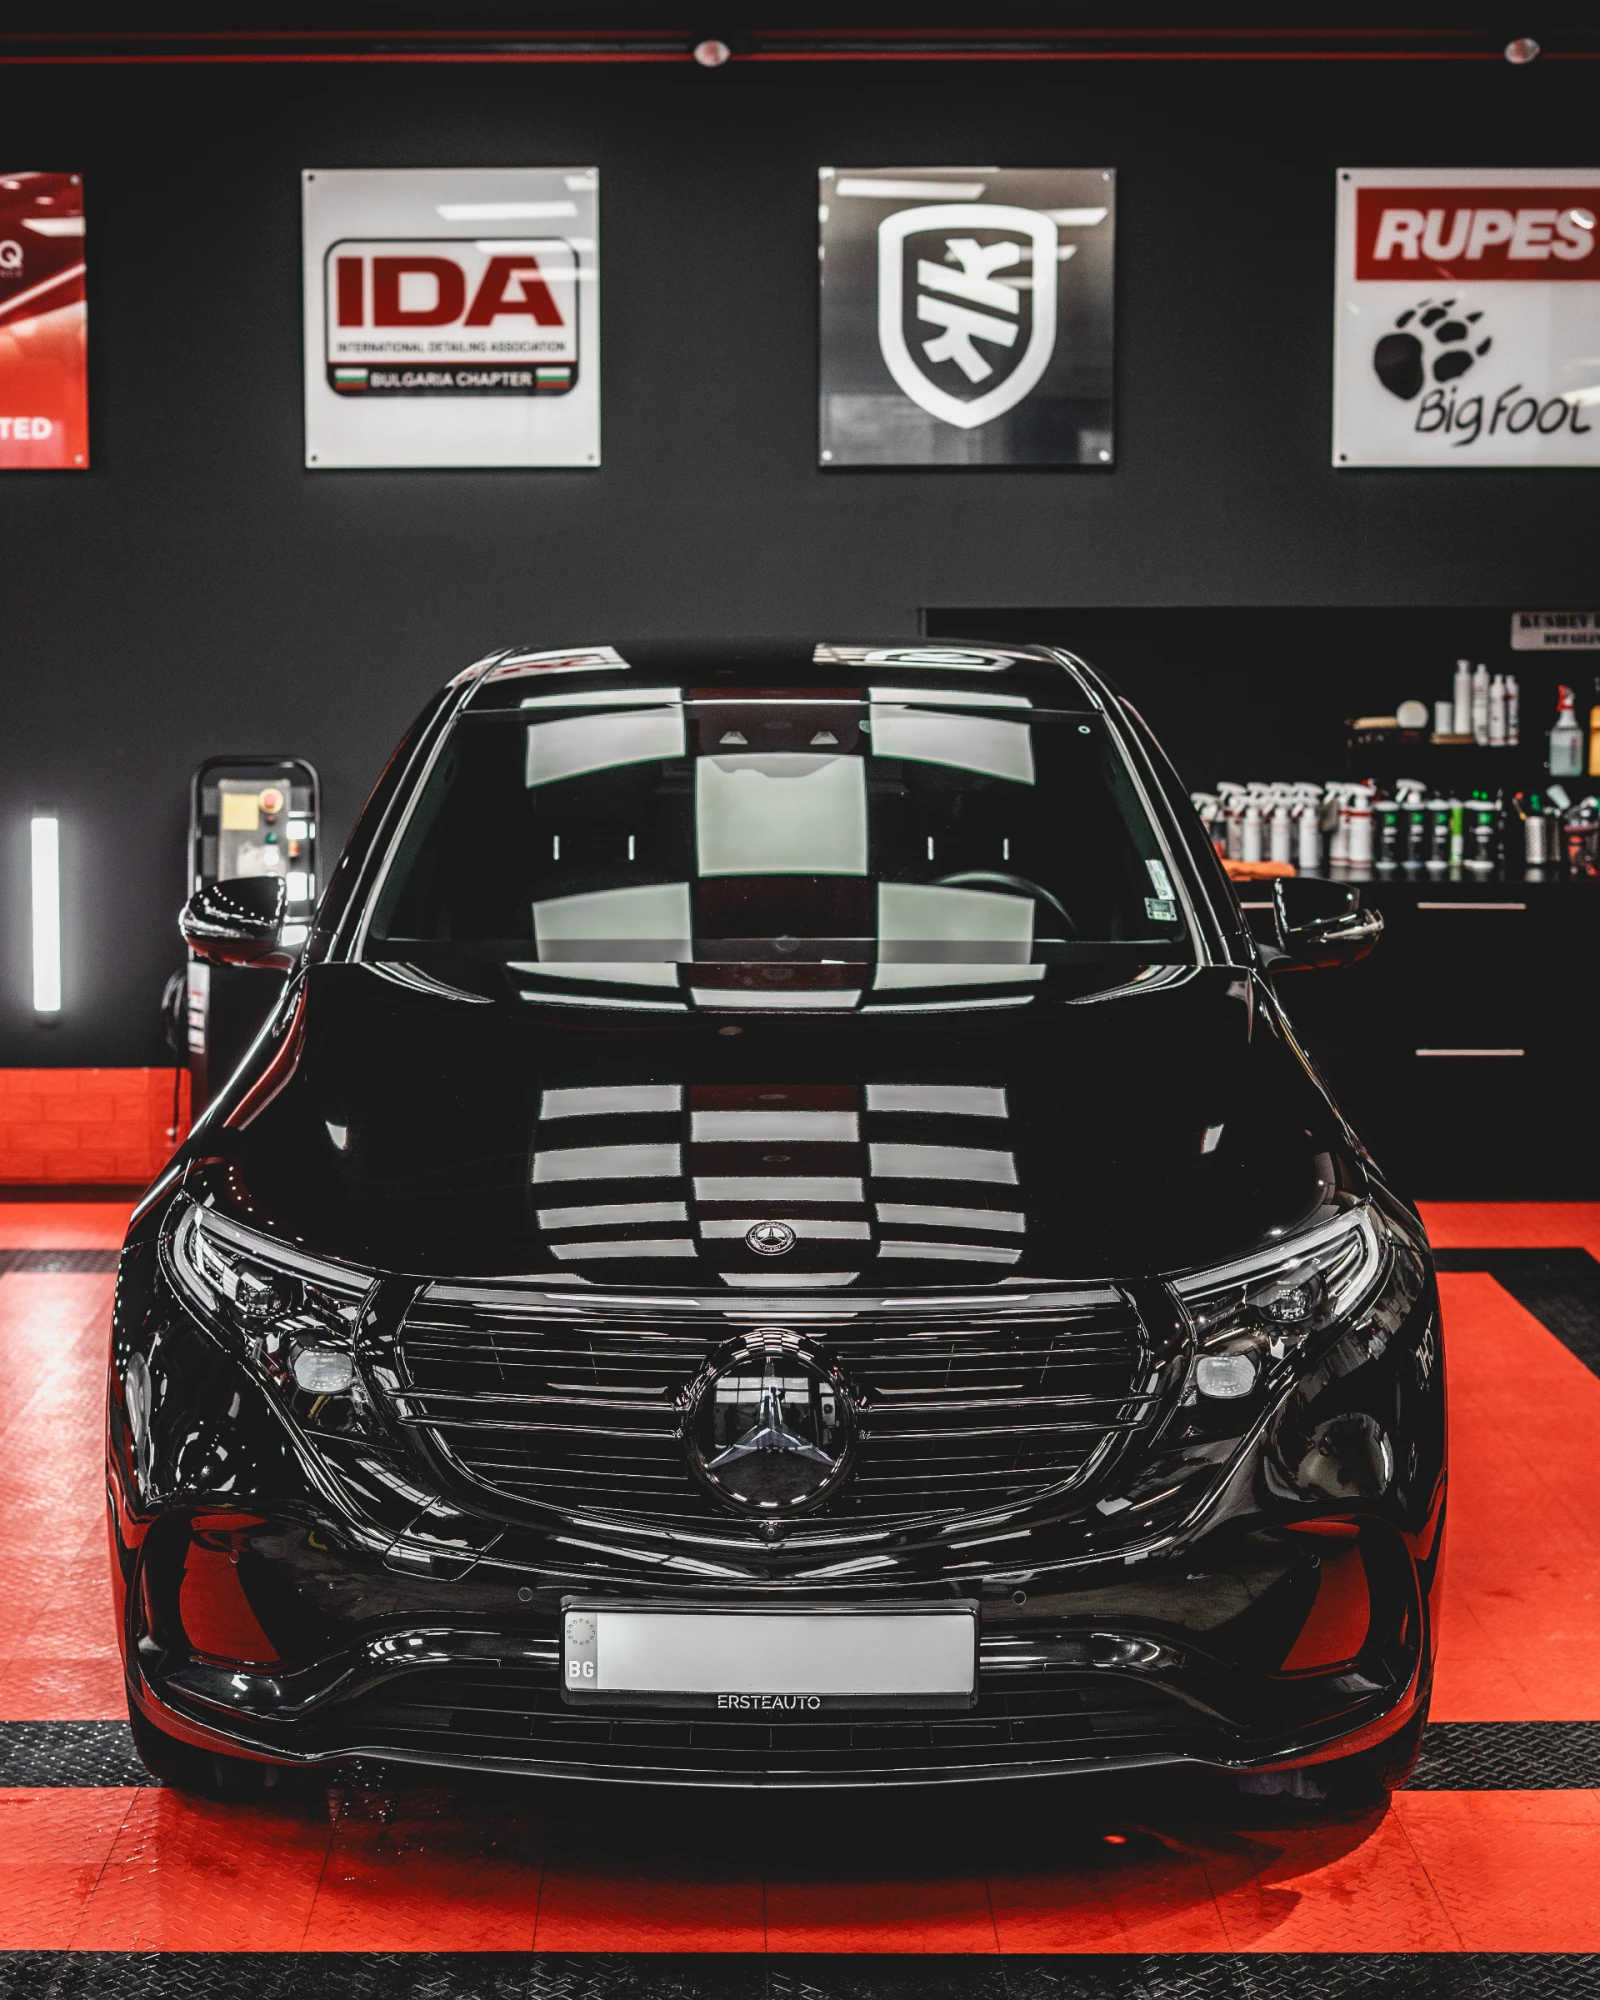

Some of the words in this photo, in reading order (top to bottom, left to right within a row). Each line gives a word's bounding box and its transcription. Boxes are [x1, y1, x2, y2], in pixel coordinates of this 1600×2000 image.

[1373, 206, 1597, 261] RUPES
[336, 254, 565, 328] IDA
[337, 341, 424, 354] INTERNATIONAL
[429, 341, 487, 354] DETAILING
[490, 340, 566, 353] ASSOCIATION
[370, 372, 454, 388] BULGARIA
[455, 371, 532, 387] CHAPTER
[568, 1660, 594, 1678] BG
[717, 1694, 820, 1710] ERSTEAUTO
